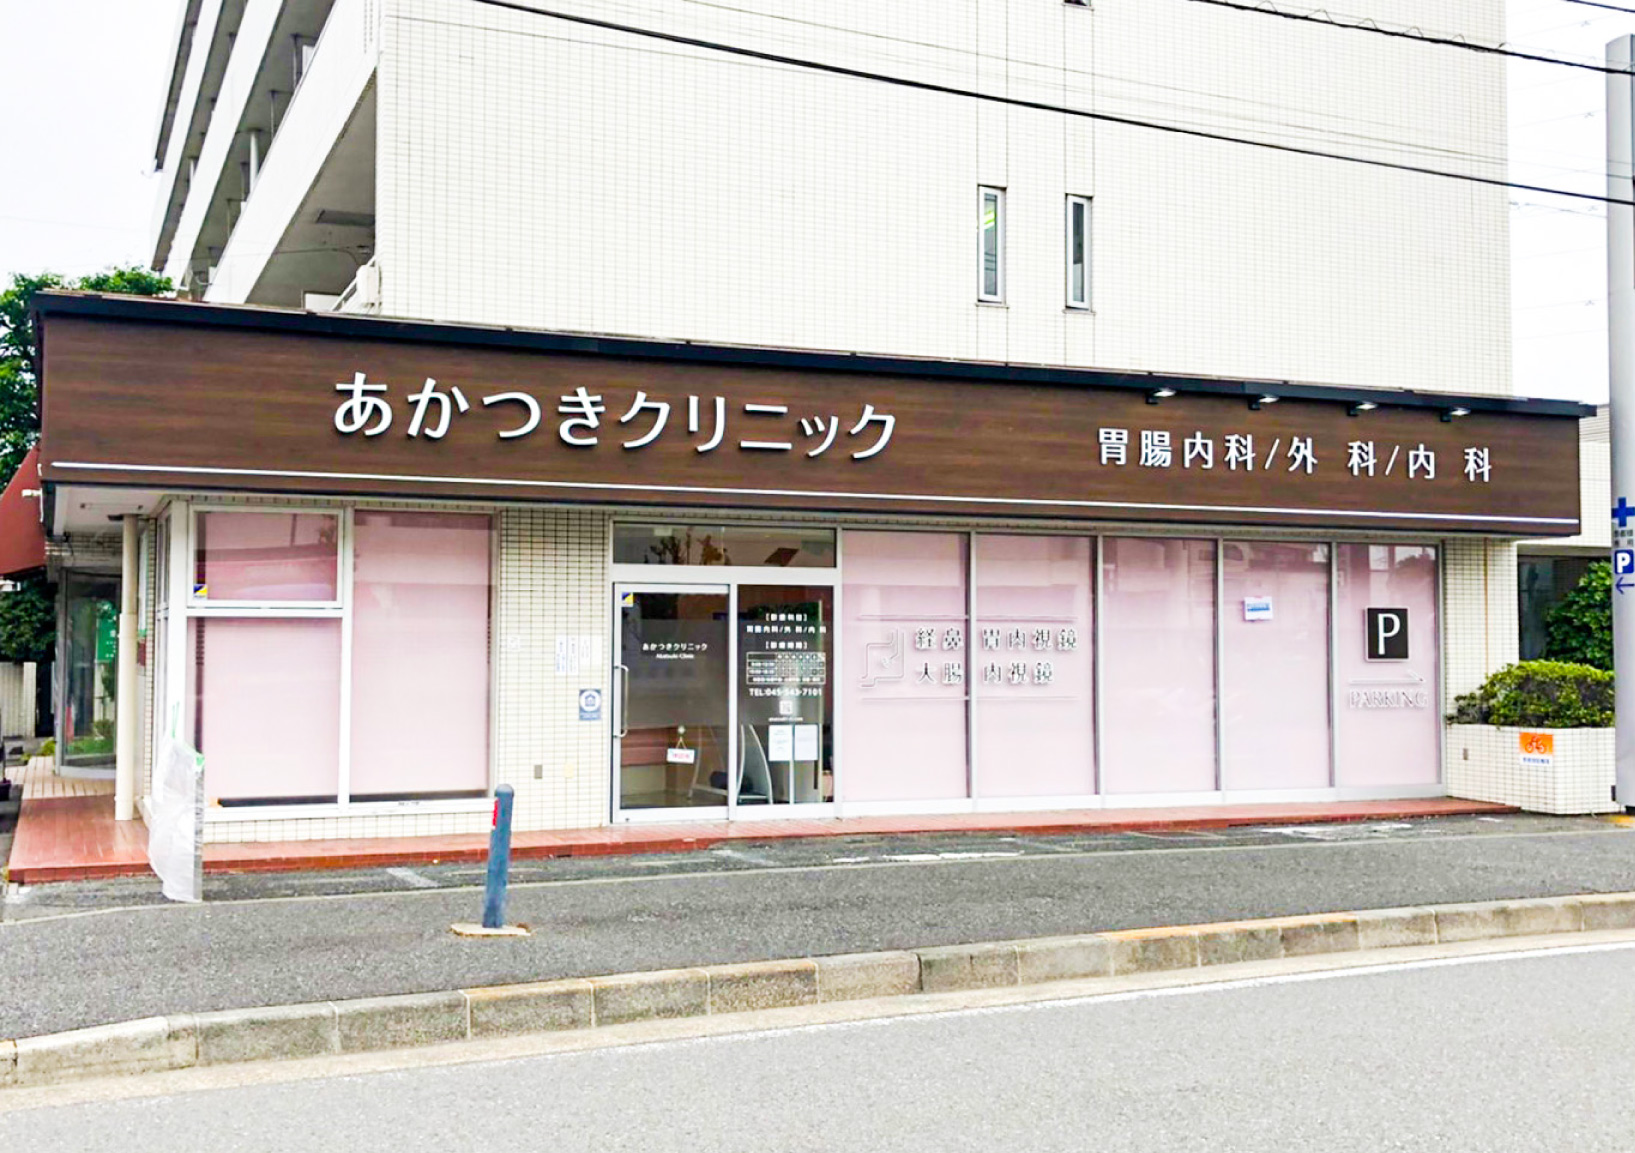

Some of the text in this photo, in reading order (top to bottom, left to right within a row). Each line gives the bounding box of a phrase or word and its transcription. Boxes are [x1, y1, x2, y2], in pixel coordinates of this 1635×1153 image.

[333, 371, 896, 460] あかつきクリニック
[1616, 552, 1631, 573] P
[1377, 612, 1401, 656] P
[1349, 689, 1430, 709] PARKING
